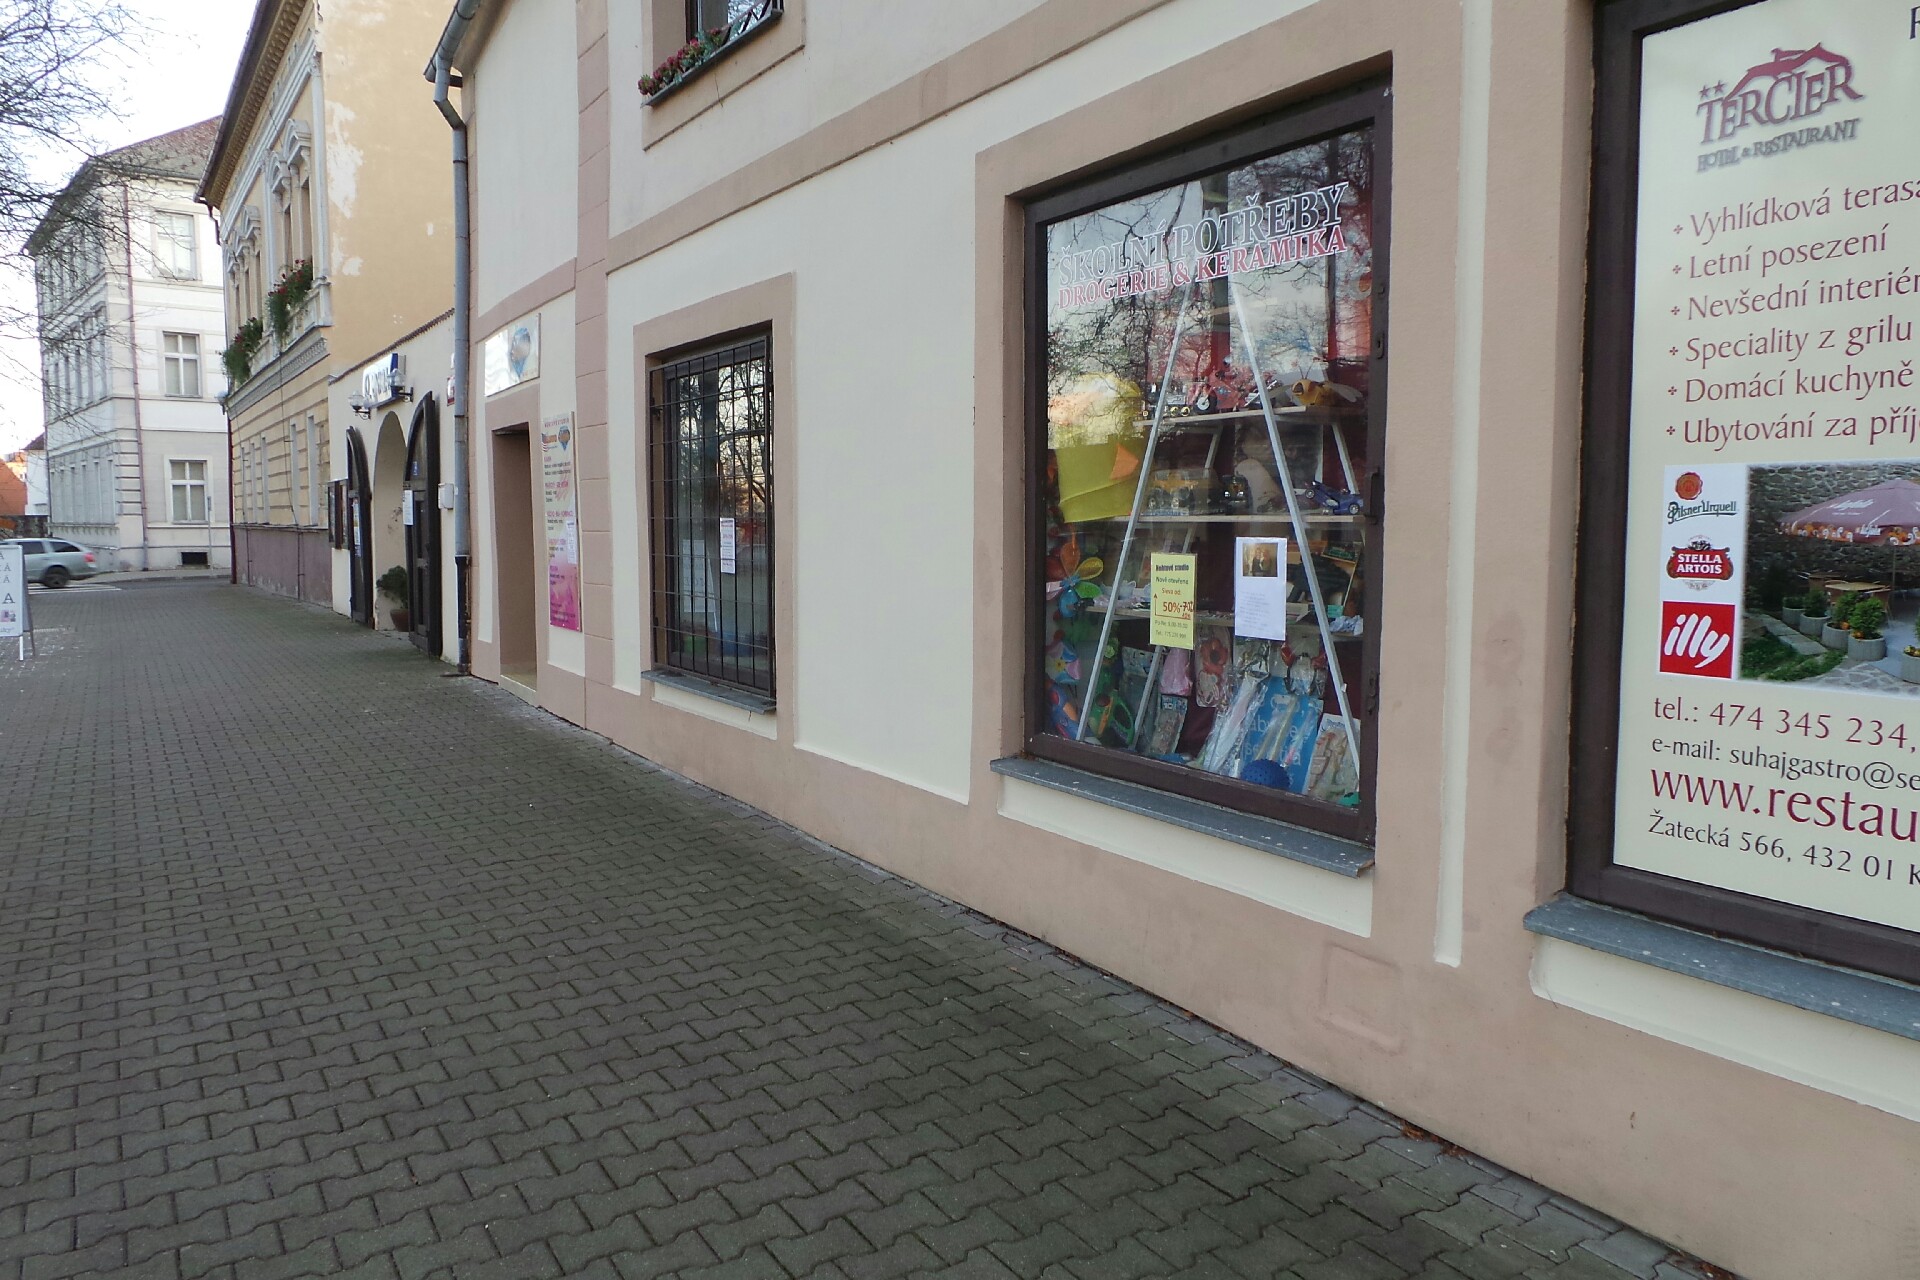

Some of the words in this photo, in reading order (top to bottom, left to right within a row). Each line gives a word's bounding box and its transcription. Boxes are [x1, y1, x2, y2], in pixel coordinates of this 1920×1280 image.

[1697, 62, 1863, 145] TERCIER
[1697, 145, 1741, 172] HOTEL
[1752, 117, 1861, 158] RESTAURANT
[1059, 219, 1167, 286] ŠKOLNÍ
[1172, 181, 1349, 262] POTŘEBY
[1690, 188, 1830, 246] Vyhlídková
[1059, 264, 1169, 309] DROGERIE
[1173, 261, 1191, 287] &
[1195, 225, 1348, 282] KERAMIKA
[1690, 245, 1752, 278] Letní
[1762, 223, 1889, 277] posezení
[1688, 279, 1809, 320] Nevšední
[1685, 327, 1809, 369] Speciality
[1817, 329, 1835, 349] z
[1846, 314, 1912, 356] grilu
[1686, 370, 1786, 402] Domácí
[1796, 359, 1914, 401] kuchyně
[1684, 411, 1815, 452] Ubytování
[1824, 417, 1857, 436] za
[1870, 405, 1920, 445] příj
[1667, 501, 1702, 525] Pilsner
[1701, 500, 1737, 517] Urquell
[1676, 564, 1723, 574] ARTOIS
[1677, 553, 1723, 564] STELLA
[1664, 613, 1730, 668] illy
[1652, 738, 1721, 761] e-mail:
[1654, 696, 1699, 723] tel.:
[1709, 702, 1763, 730] 474
[1776, 709, 1832, 739] 345
[1845, 717, 1916, 753] 234,
[1651, 769, 1918, 843] www.restau
[1648, 808, 1729, 848] Žatecká
[1739, 831, 1791, 863] 566,
[1802, 844, 1851, 872] 432
[1863, 855, 1892, 880] 01
